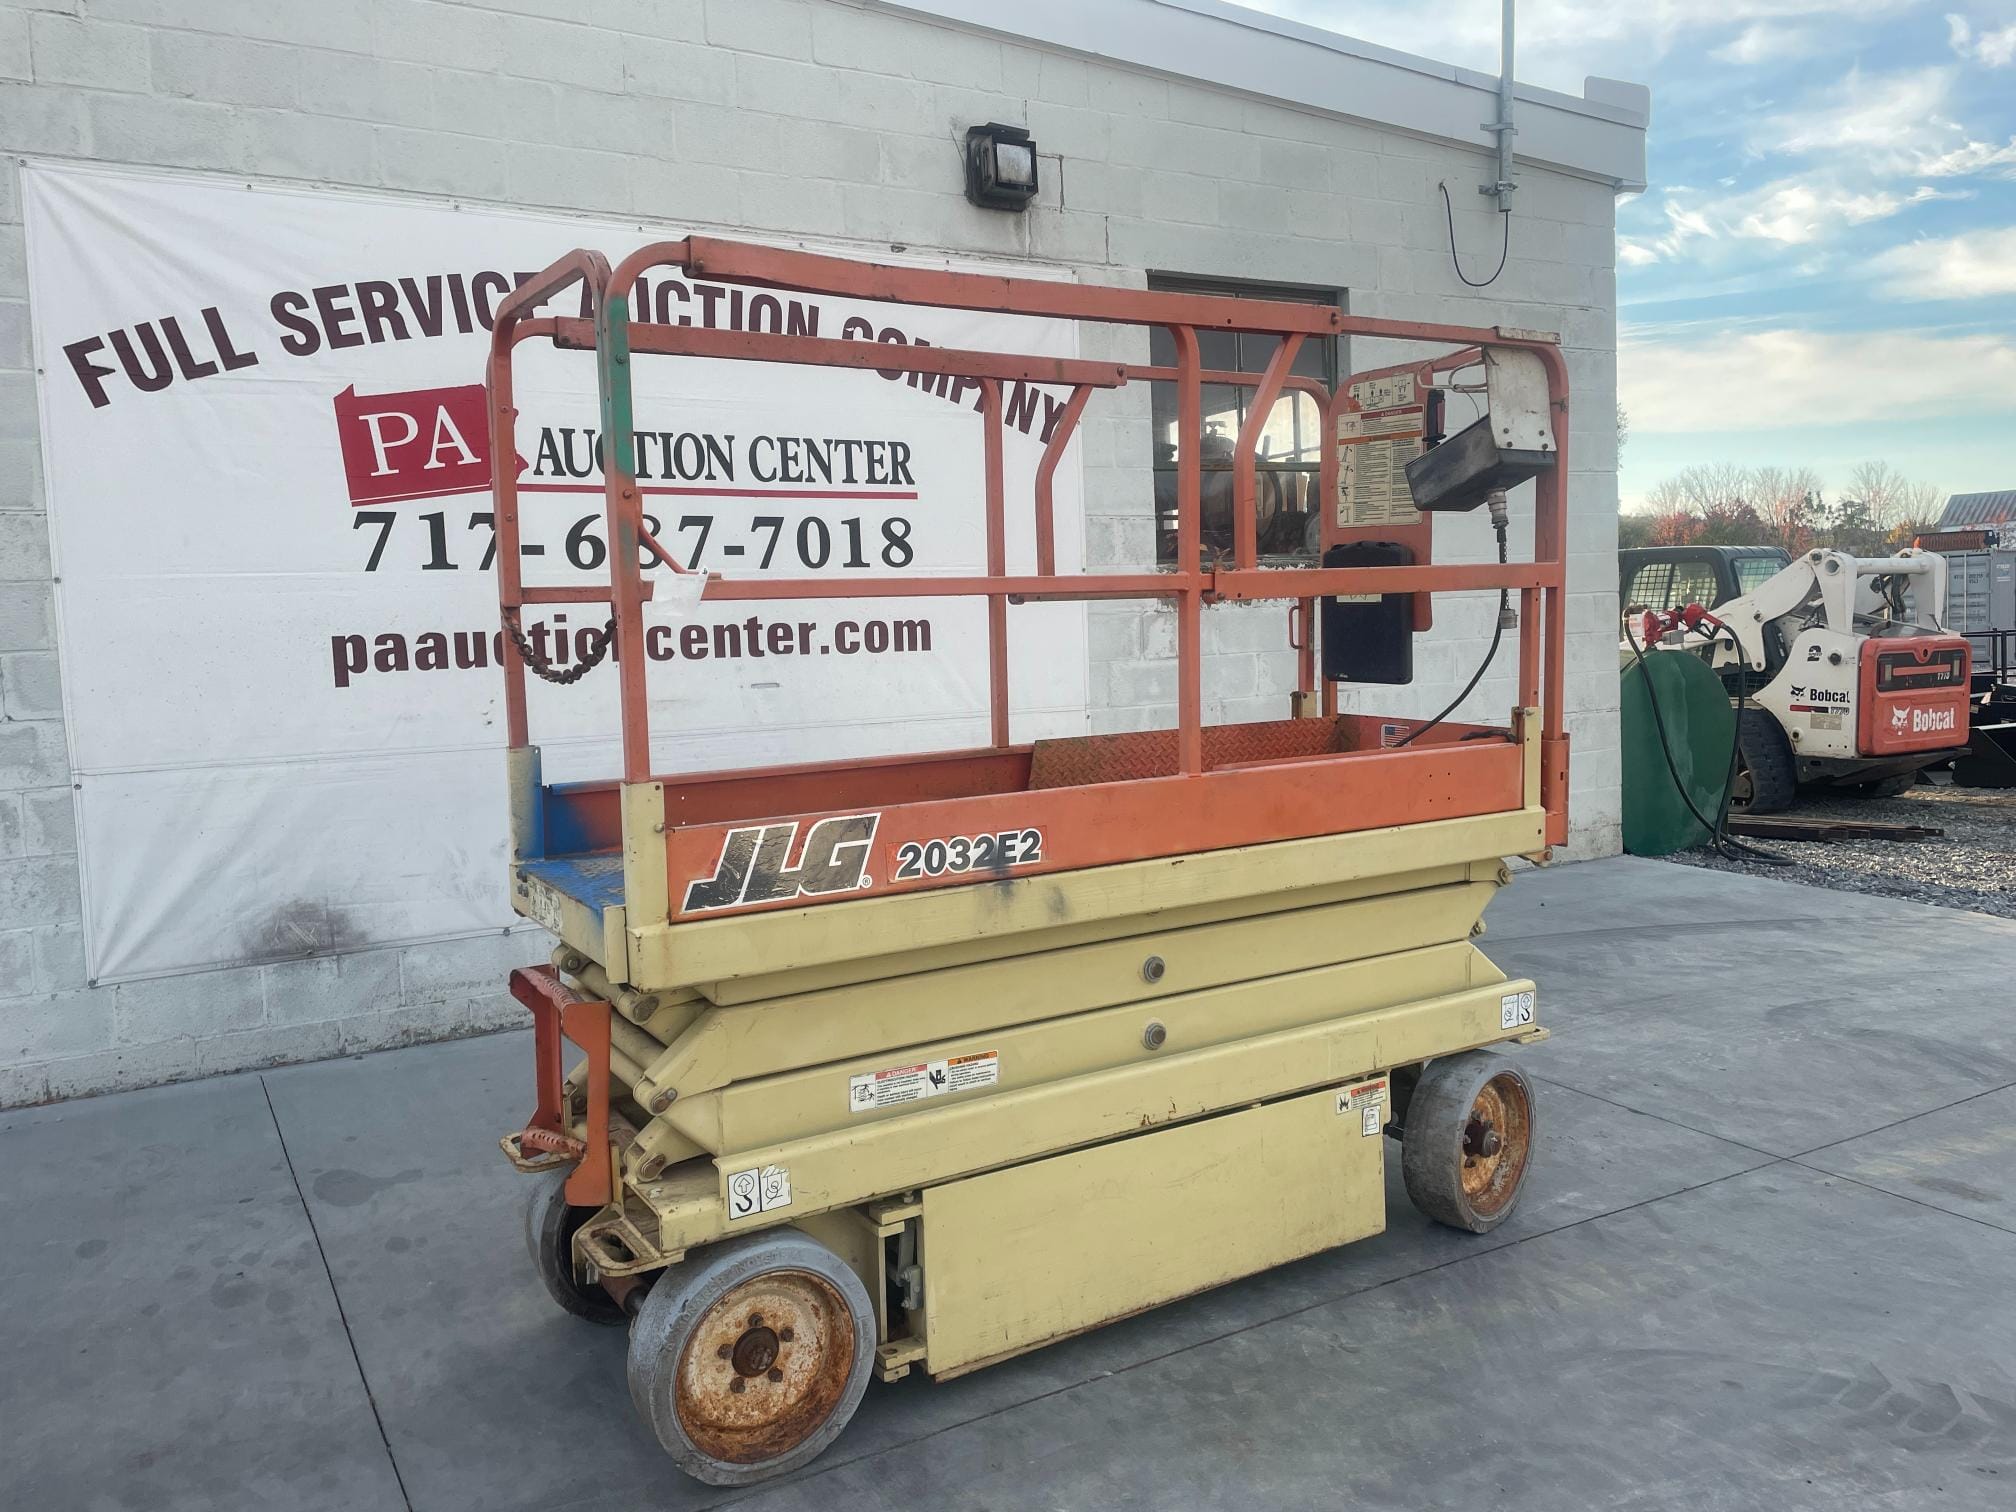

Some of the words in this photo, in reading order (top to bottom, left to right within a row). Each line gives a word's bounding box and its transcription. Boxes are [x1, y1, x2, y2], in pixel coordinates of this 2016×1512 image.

[62, 306, 259, 409] FULL
[579, 276, 818, 337] CTION
[842, 316, 1066, 446] OMPNY
[357, 405, 482, 477] PA
[533, 428, 735, 481] AUTION
[748, 433, 916, 486] CENTER
[331, 612, 932, 688] paautiocenter.com
[1912, 707, 1955, 732] Bobcat
[680, 812, 882, 914] JLG
[895, 826, 1043, 882] 2032E2
